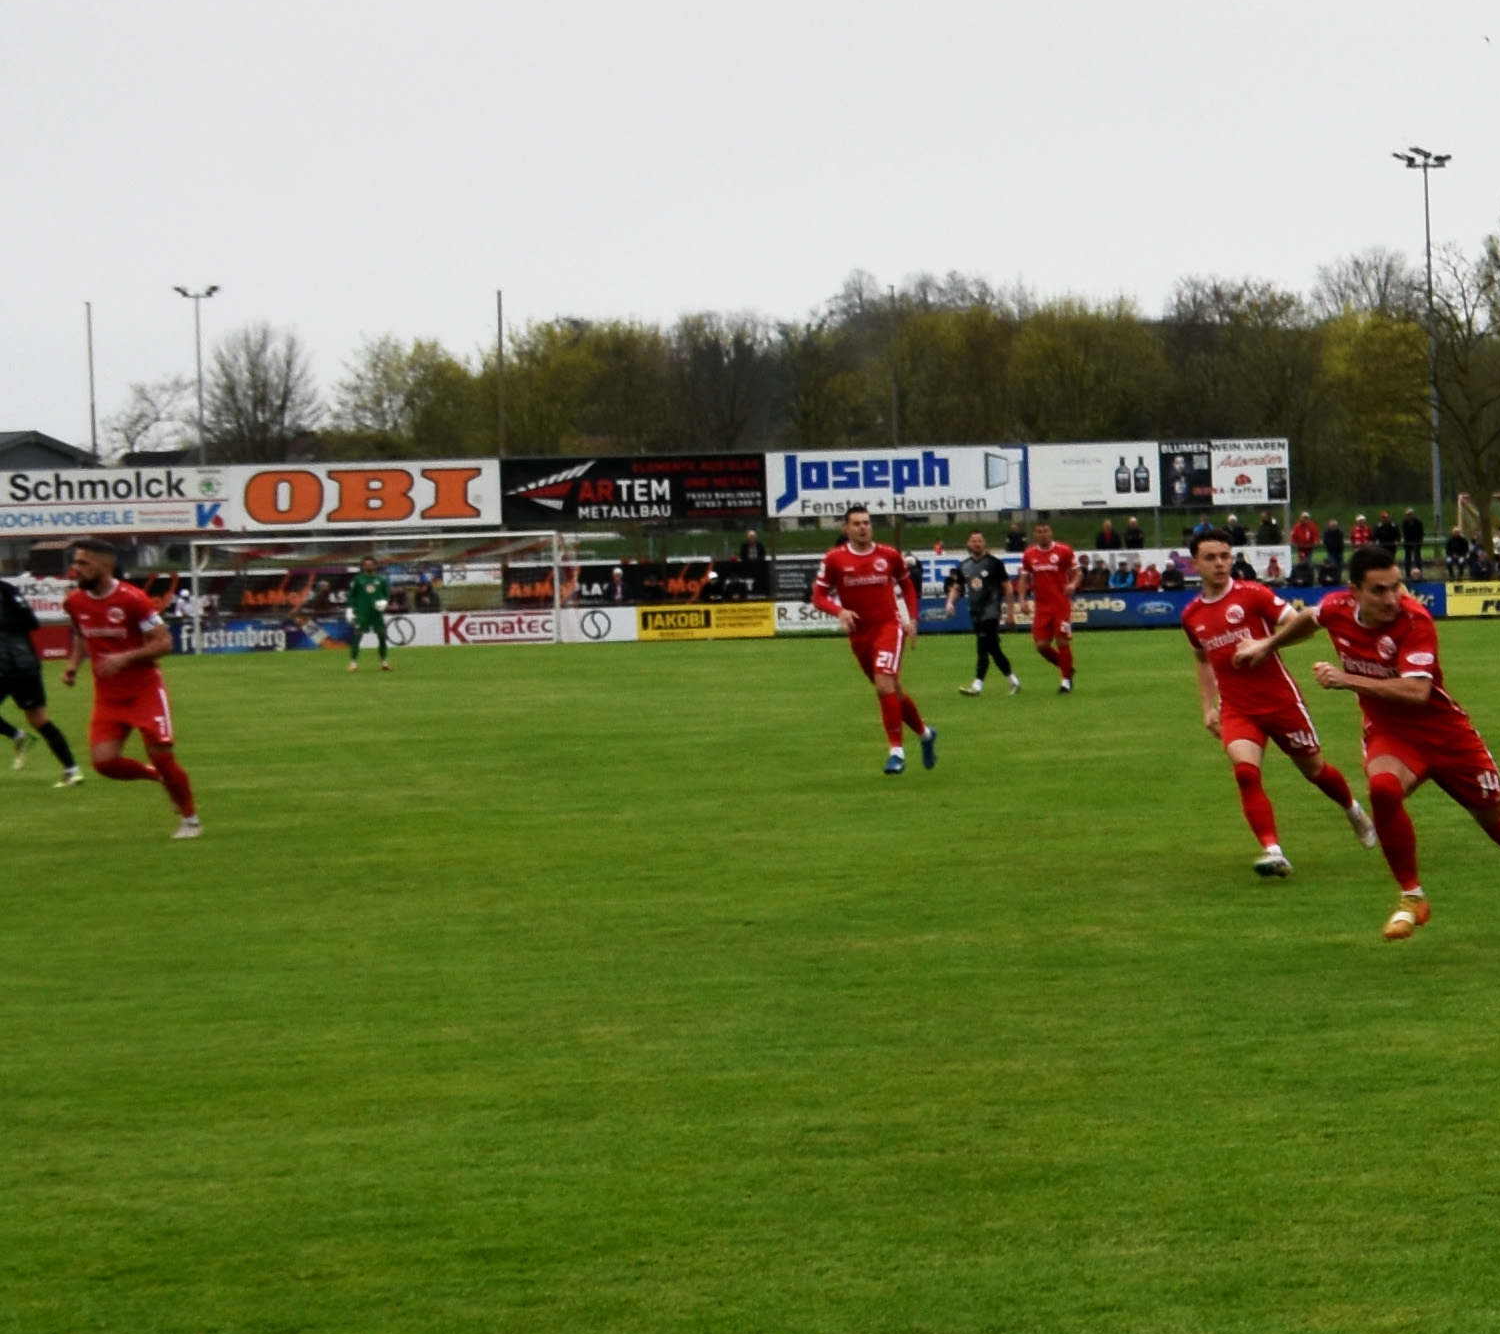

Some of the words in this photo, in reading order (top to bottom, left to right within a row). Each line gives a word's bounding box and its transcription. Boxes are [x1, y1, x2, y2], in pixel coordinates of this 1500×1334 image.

[1160, 443, 1210, 454] BLUMEN
[9, 470, 186, 502] Schmolck
[578, 478, 671, 503] ARTEM
[776, 450, 950, 514] Joseph
[244, 468, 482, 524] OBI
[801, 498, 870, 514] Fenster
[893, 496, 987, 512] Haustüren
[0, 510, 134, 529] OCH-VOEGELE
[578, 504, 671, 520] METALLBAU
[443, 614, 553, 644] Kematec
